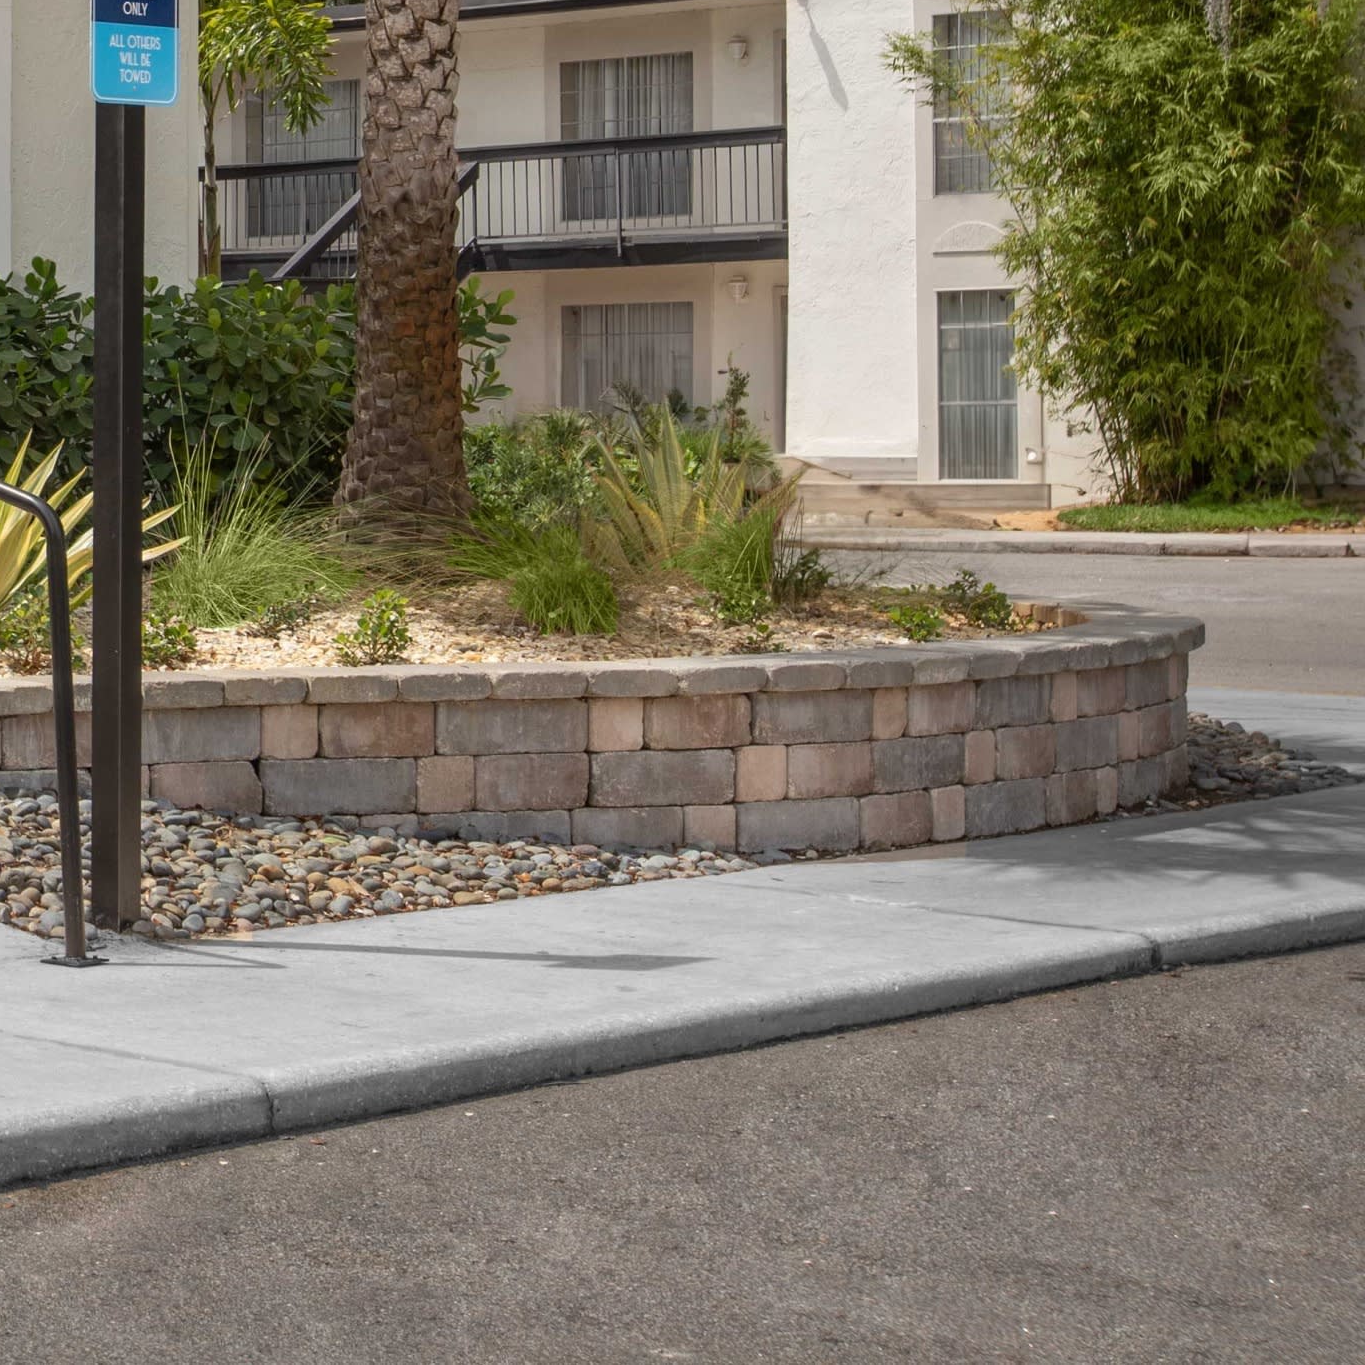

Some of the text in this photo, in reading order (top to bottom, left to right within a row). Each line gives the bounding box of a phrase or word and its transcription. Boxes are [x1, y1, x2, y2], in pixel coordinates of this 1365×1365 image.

[122, 1, 148, 17] ONLY
[109, 34, 161, 51] ALL OTHERS
[119, 52, 151, 67] WILL BE
[119, 68, 151, 84] TOWED
